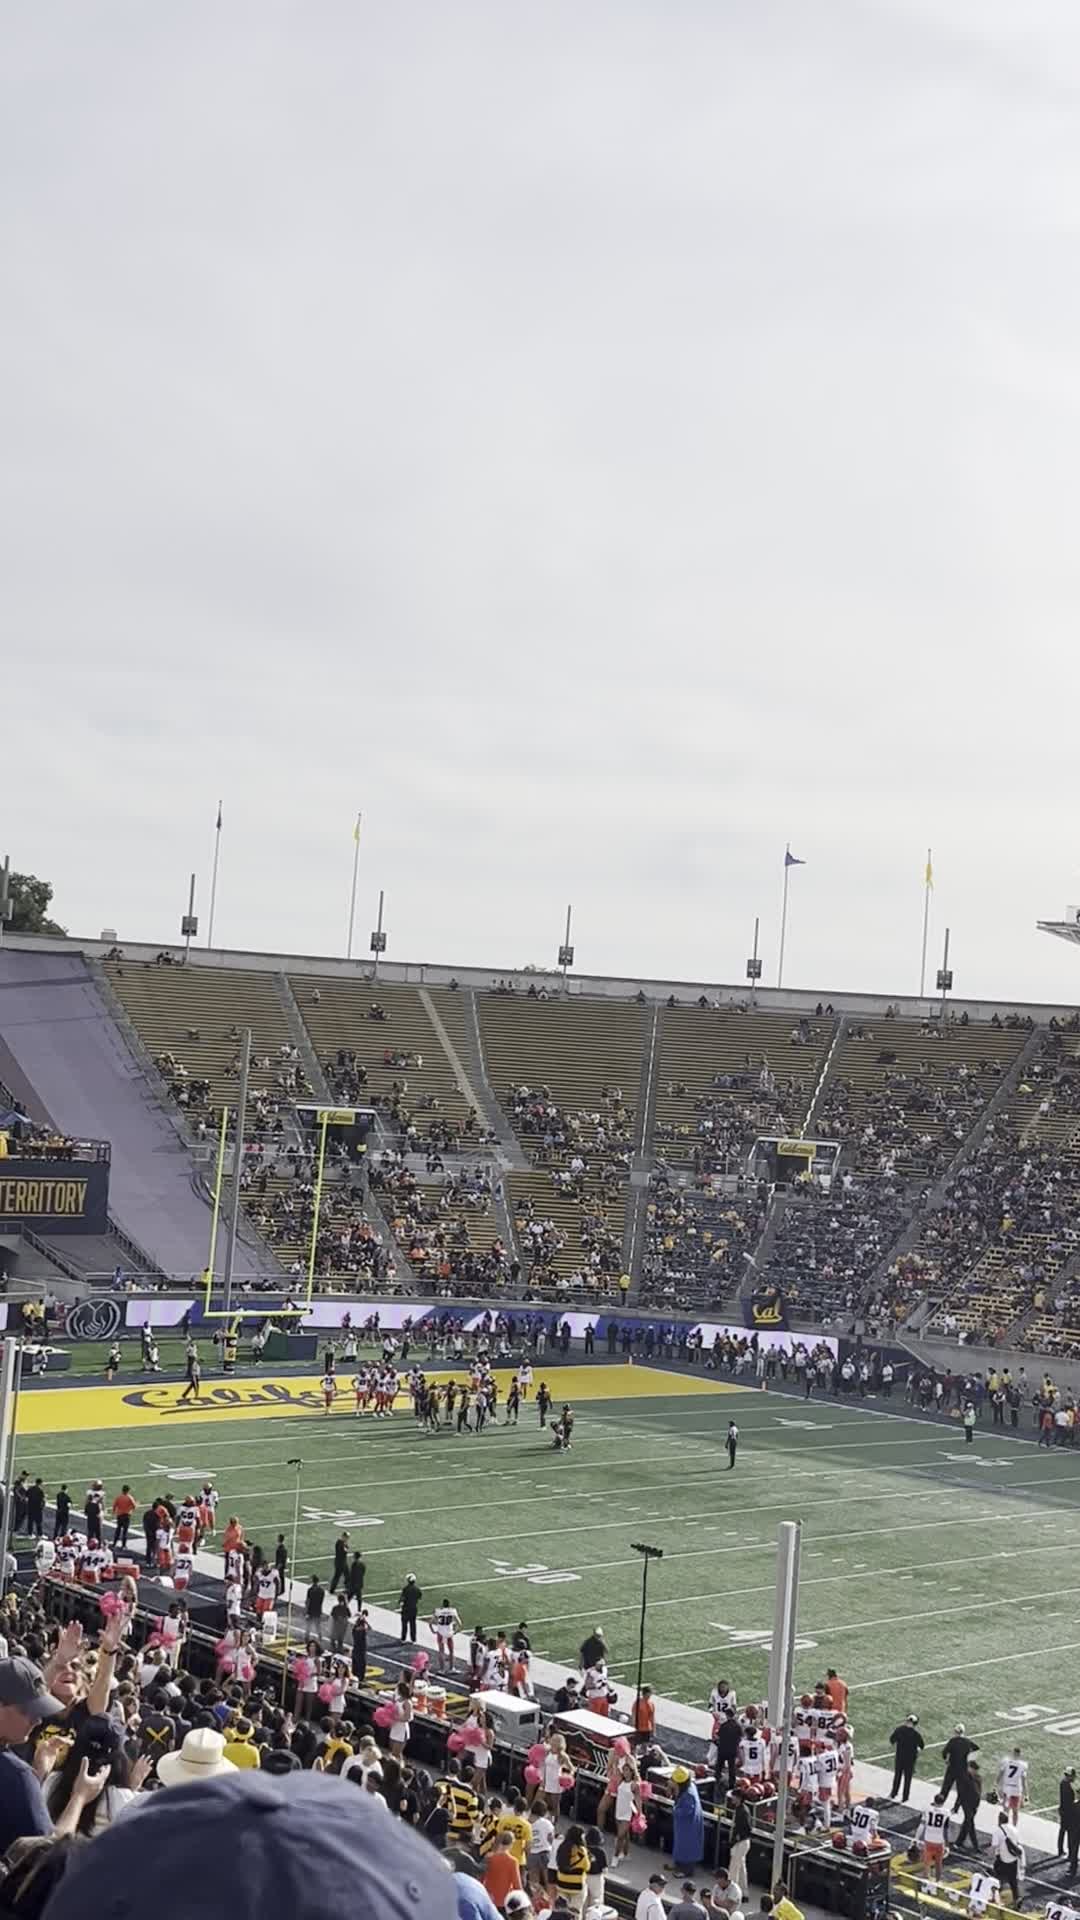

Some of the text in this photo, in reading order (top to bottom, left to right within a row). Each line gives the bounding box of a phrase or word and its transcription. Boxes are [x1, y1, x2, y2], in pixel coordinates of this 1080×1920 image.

[0, 1181, 88, 1213] TERRITORY
[752, 1297, 783, 1324] Cal
[716, 1702, 729, 1714] 12
[796, 1713, 813, 1727] 54
[818, 1714, 834, 1730] 82
[749, 1747, 758, 1760] 6
[824, 1758, 837, 1773] 31
[1008, 1765, 1018, 1779] 7
[853, 1810, 869, 1829] 30
[928, 1812, 944, 1828] 18
[975, 1879, 983, 1893] 1
[1046, 1907, 1063, 1920] 14
